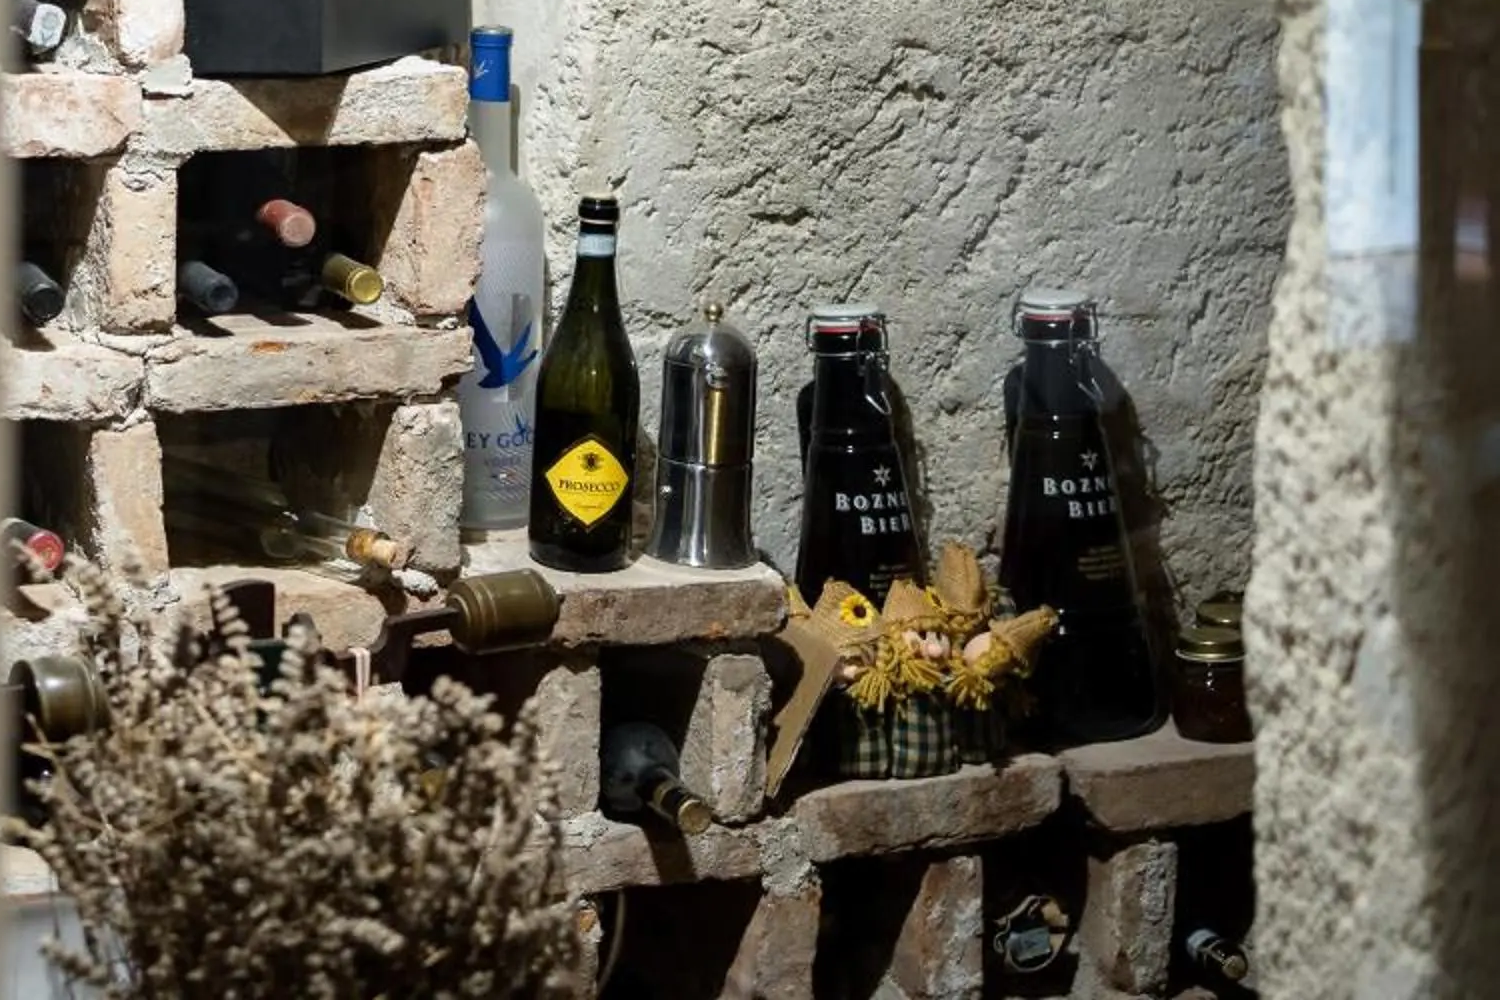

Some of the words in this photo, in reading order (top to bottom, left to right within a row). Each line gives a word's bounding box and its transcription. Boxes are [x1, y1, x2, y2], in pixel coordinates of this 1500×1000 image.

[467, 432, 491, 449] EY
[558, 479, 621, 493] PROSECCO
[1043, 475, 1115, 495] BOZN
